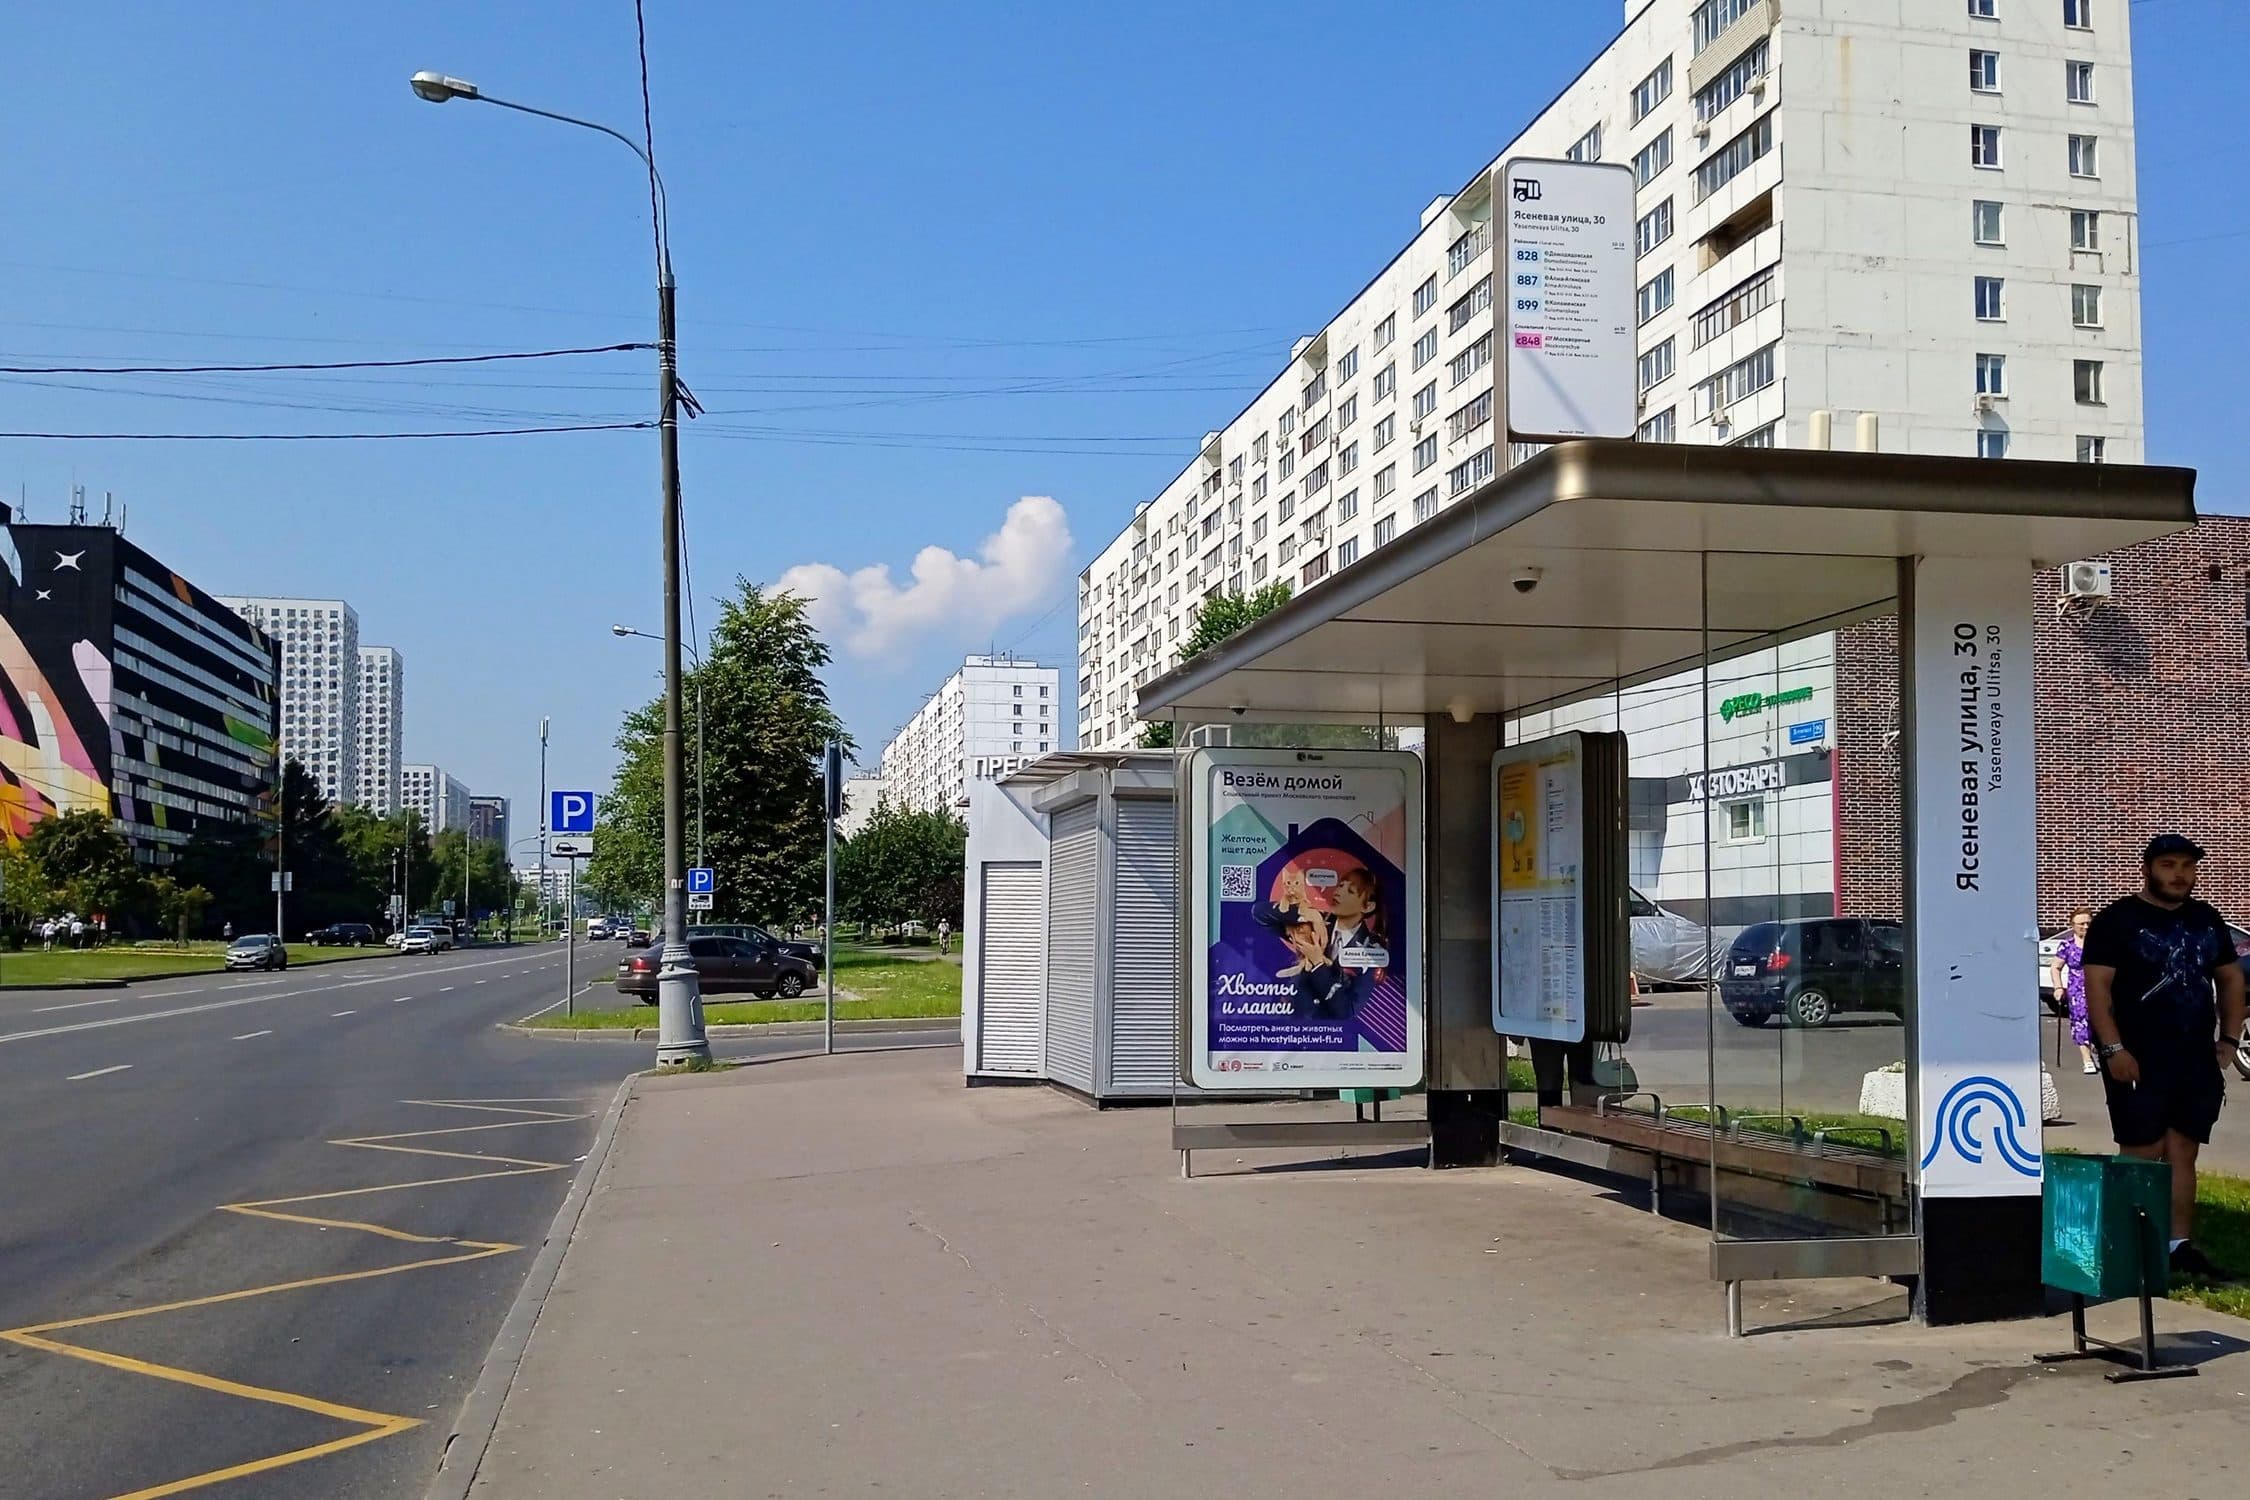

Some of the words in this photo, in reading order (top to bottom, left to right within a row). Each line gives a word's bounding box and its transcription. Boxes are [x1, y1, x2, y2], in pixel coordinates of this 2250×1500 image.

[1513, 210, 1560, 222] Ясеневая
[1561, 214, 1591, 225] улица,
[1593, 215, 1606, 225] 30
[1516, 250, 1538, 262] 828
[1517, 275, 1538, 286] 887
[1517, 299, 1539, 311] 899
[1954, 622, 1977, 657] 30
[1987, 625, 2001, 645] 30
[1987, 648, 2003, 697] Ulitsa,
[1960, 665, 1984, 754] улица,
[1988, 701, 2003, 792] Yasenevaya
[1223, 771, 1280, 788] Везём
[1284, 774, 1342, 790] домой
[563, 795, 586, 828] P
[1956, 760, 1979, 892] Ясеневая
[1222, 834, 1266, 844] Желточек
[1221, 847, 1245, 855] ищет
[695, 871, 709, 890] P
[1217, 973, 1298, 996] Хвосты
[1222, 1002, 1235, 1014] и
[1237, 1002, 1295, 1015] лапки
[1219, 1024, 1270, 1034] Посмотреть
[1271, 1025, 1300, 1033] анкеты
